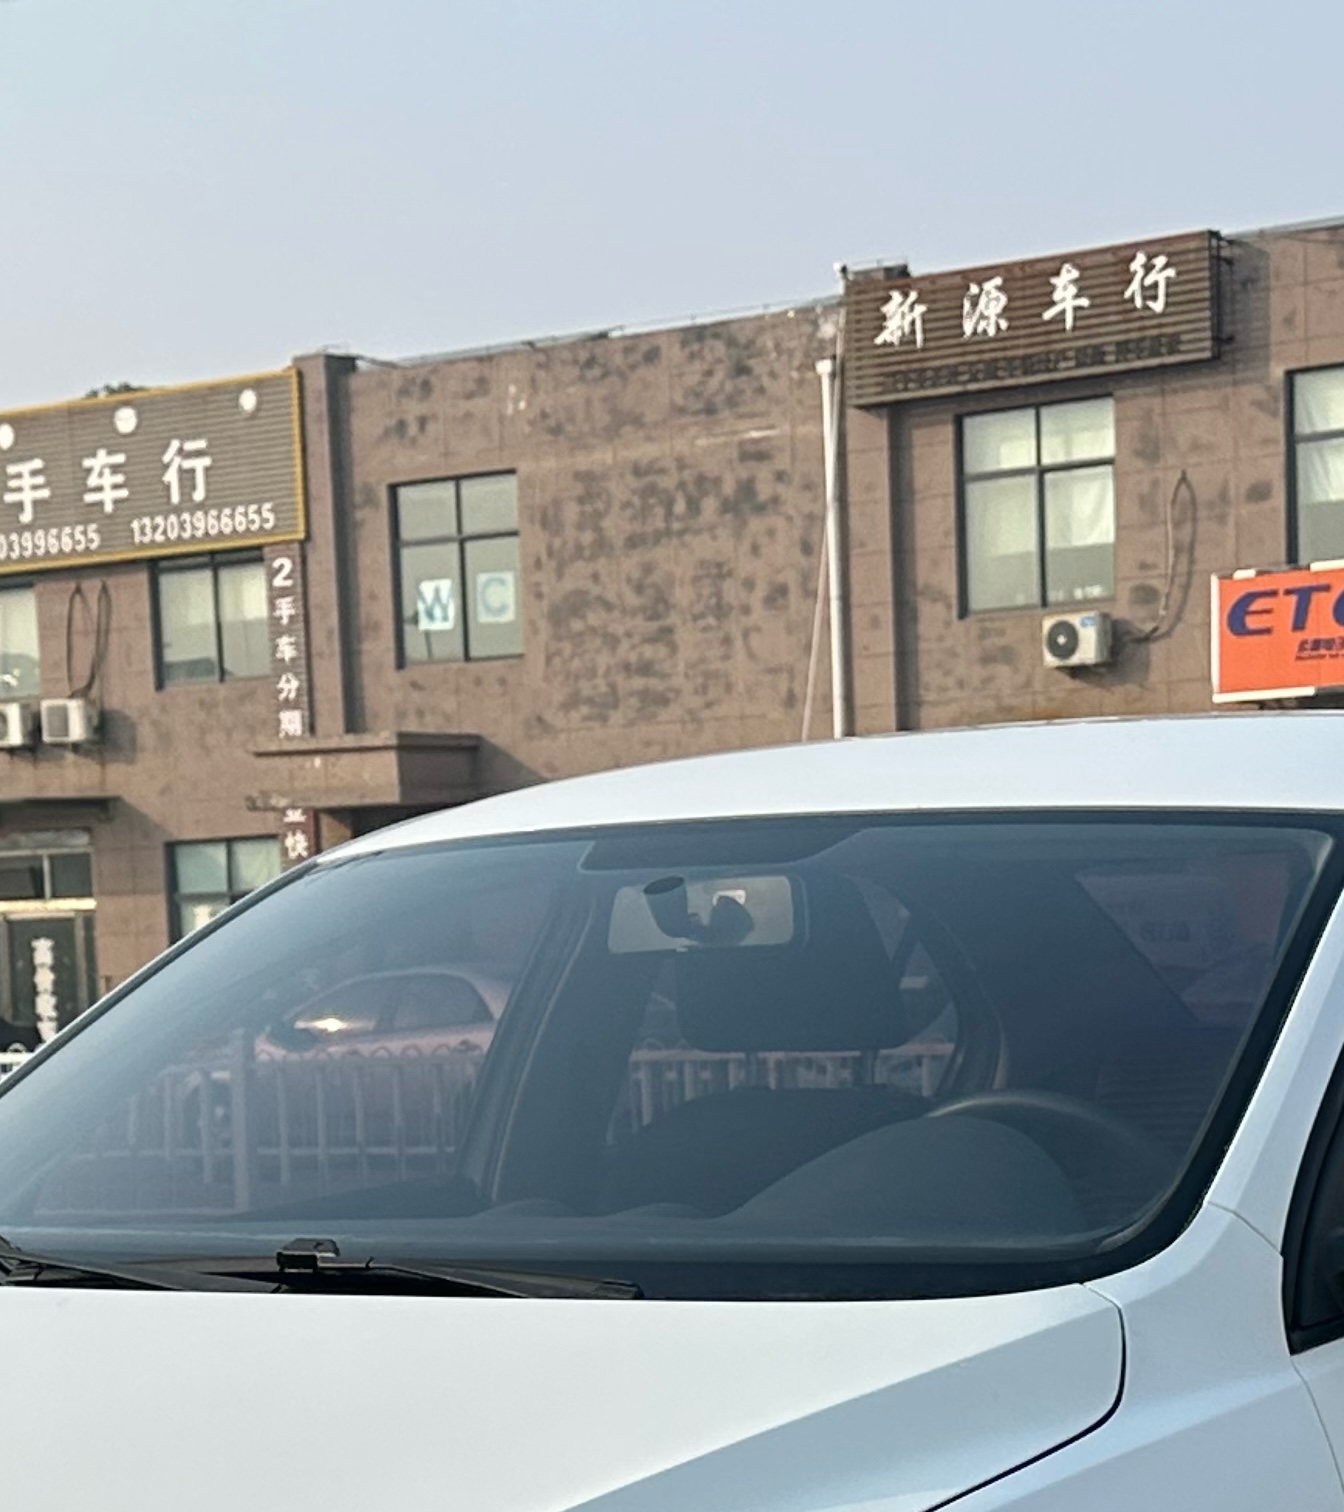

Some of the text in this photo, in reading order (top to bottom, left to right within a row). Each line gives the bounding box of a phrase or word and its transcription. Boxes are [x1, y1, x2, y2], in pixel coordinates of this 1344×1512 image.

[873, 250, 1177, 350] 新源车行
[130, 501, 276, 545] 13203966655
[271, 557, 304, 738] 2手车分期
